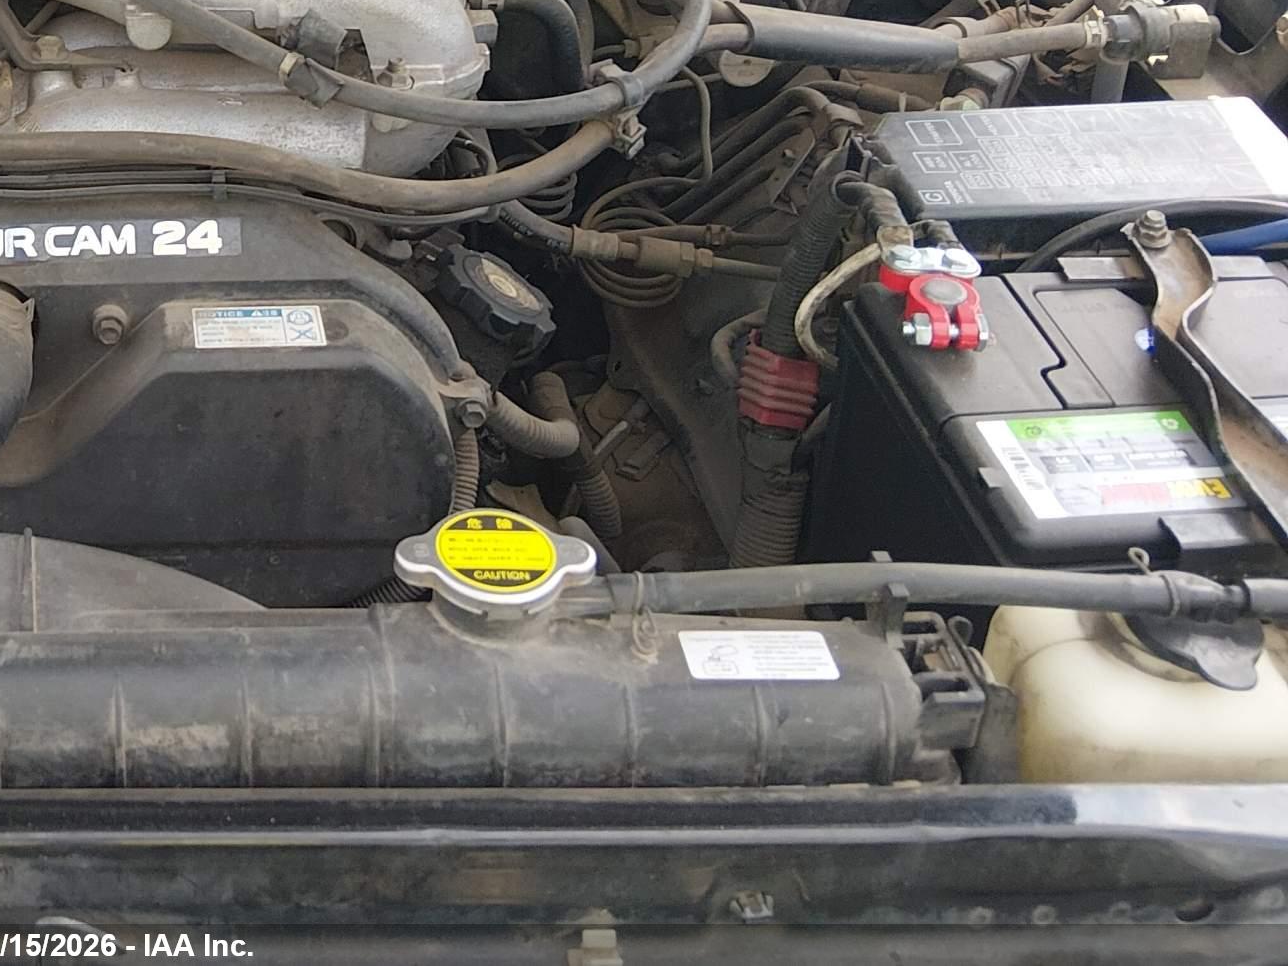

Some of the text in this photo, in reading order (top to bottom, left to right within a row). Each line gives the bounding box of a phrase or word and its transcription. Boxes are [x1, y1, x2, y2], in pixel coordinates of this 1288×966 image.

[43, 223, 136, 257] CAM
[153, 219, 223, 256] 24
[473, 569, 530, 580] CAUTION
